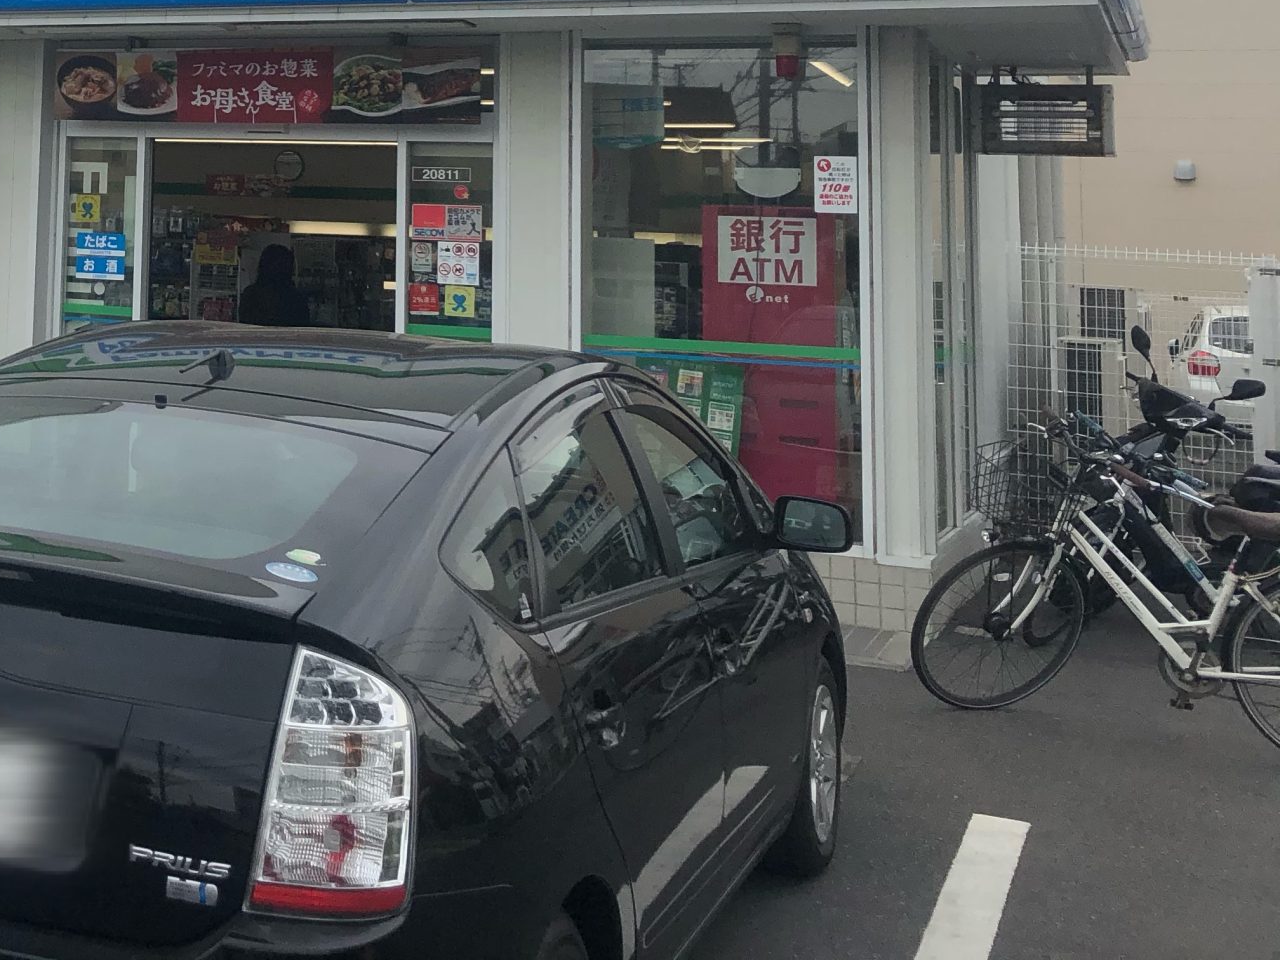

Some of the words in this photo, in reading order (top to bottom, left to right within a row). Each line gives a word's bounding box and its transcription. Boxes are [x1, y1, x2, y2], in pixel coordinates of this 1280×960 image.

[192, 58, 319, 78] ファミマのお惣菜
[190, 80, 295, 114] お母さん食堂
[422, 169, 460, 180] 20811
[84, 234, 118, 248] たばこ
[414, 228, 445, 237] SECOM
[729, 219, 806, 254] 銀行
[729, 257, 803, 284] ATM
[128, 843, 232, 878] PRIUS
